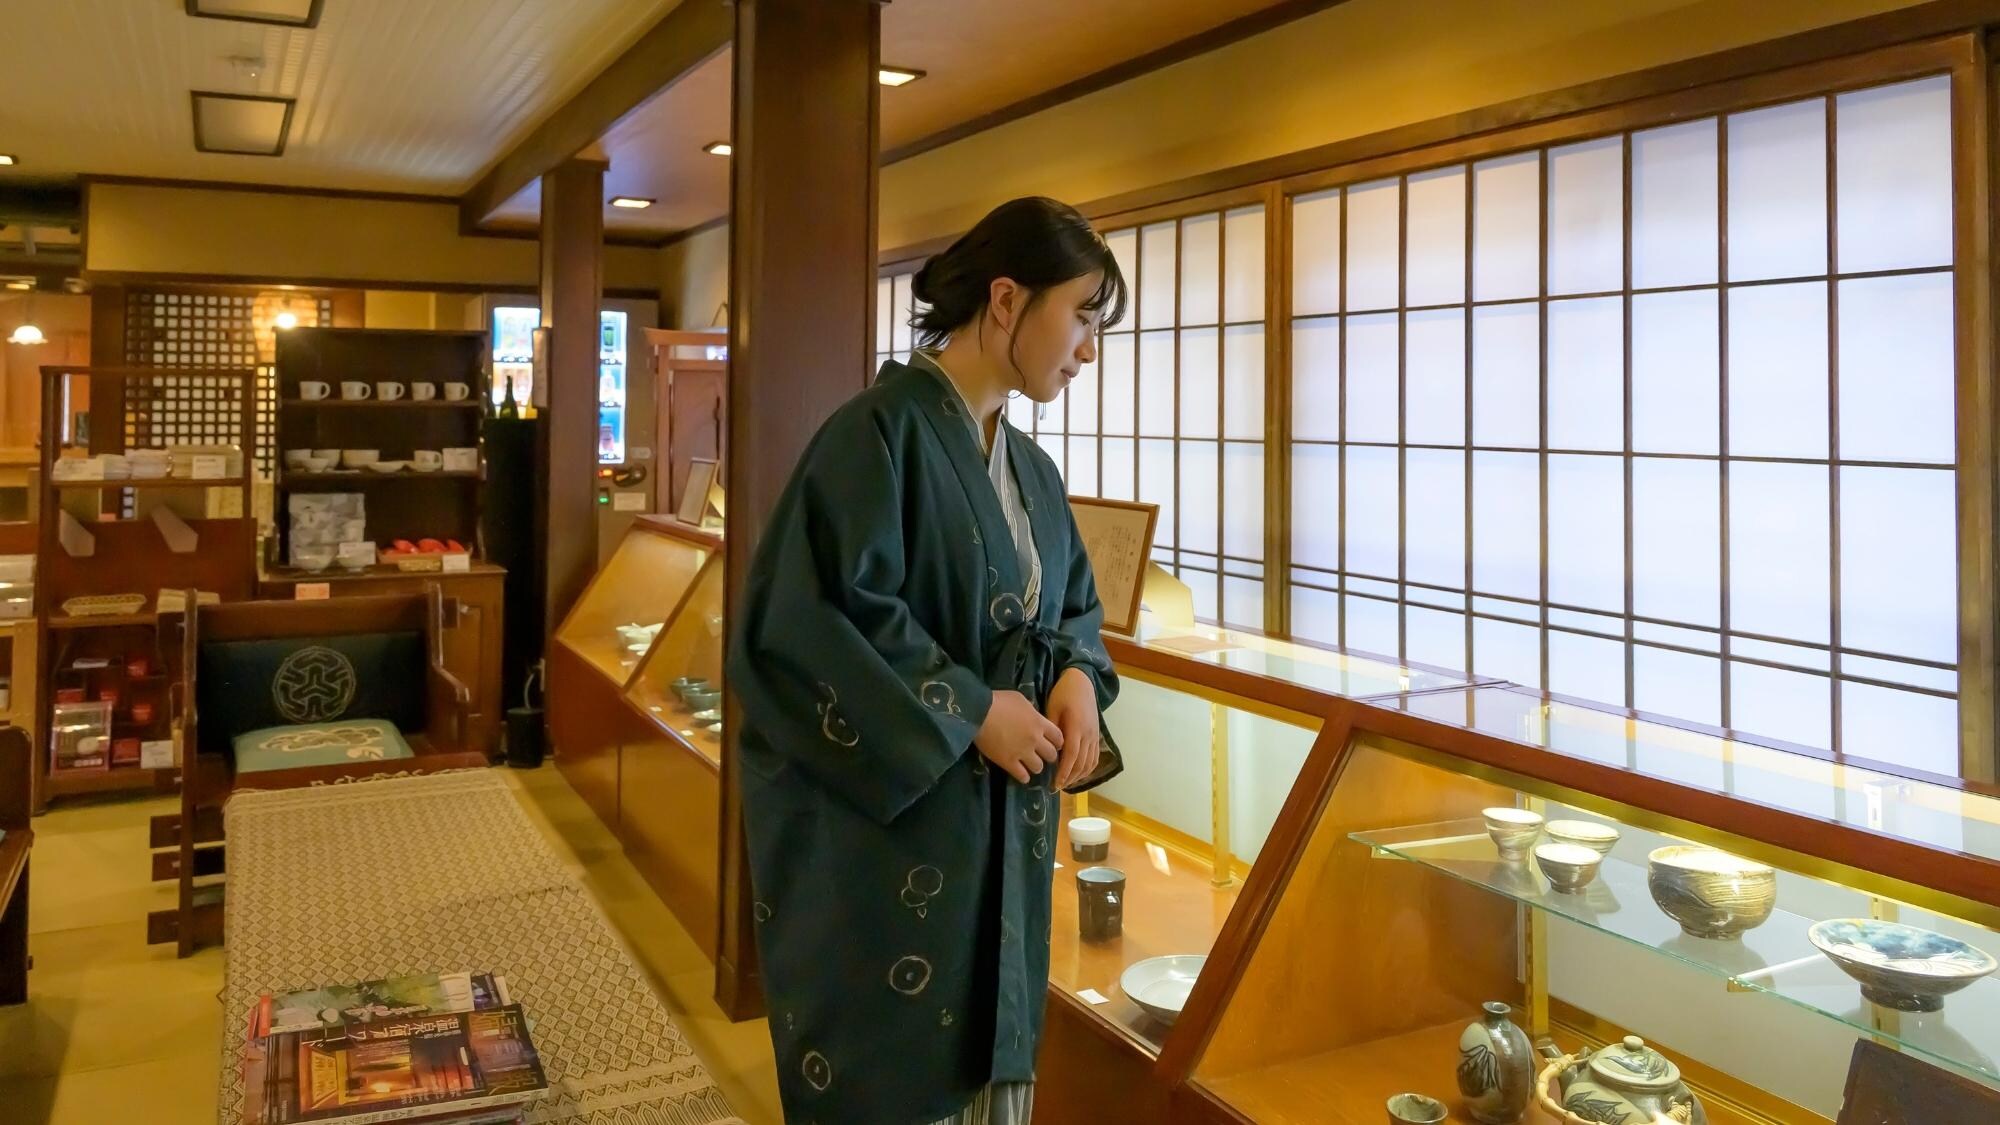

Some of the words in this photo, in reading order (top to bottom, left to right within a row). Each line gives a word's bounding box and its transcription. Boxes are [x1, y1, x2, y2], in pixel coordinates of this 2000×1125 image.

[301, 1018, 460, 1047] 温泉宿アワード
